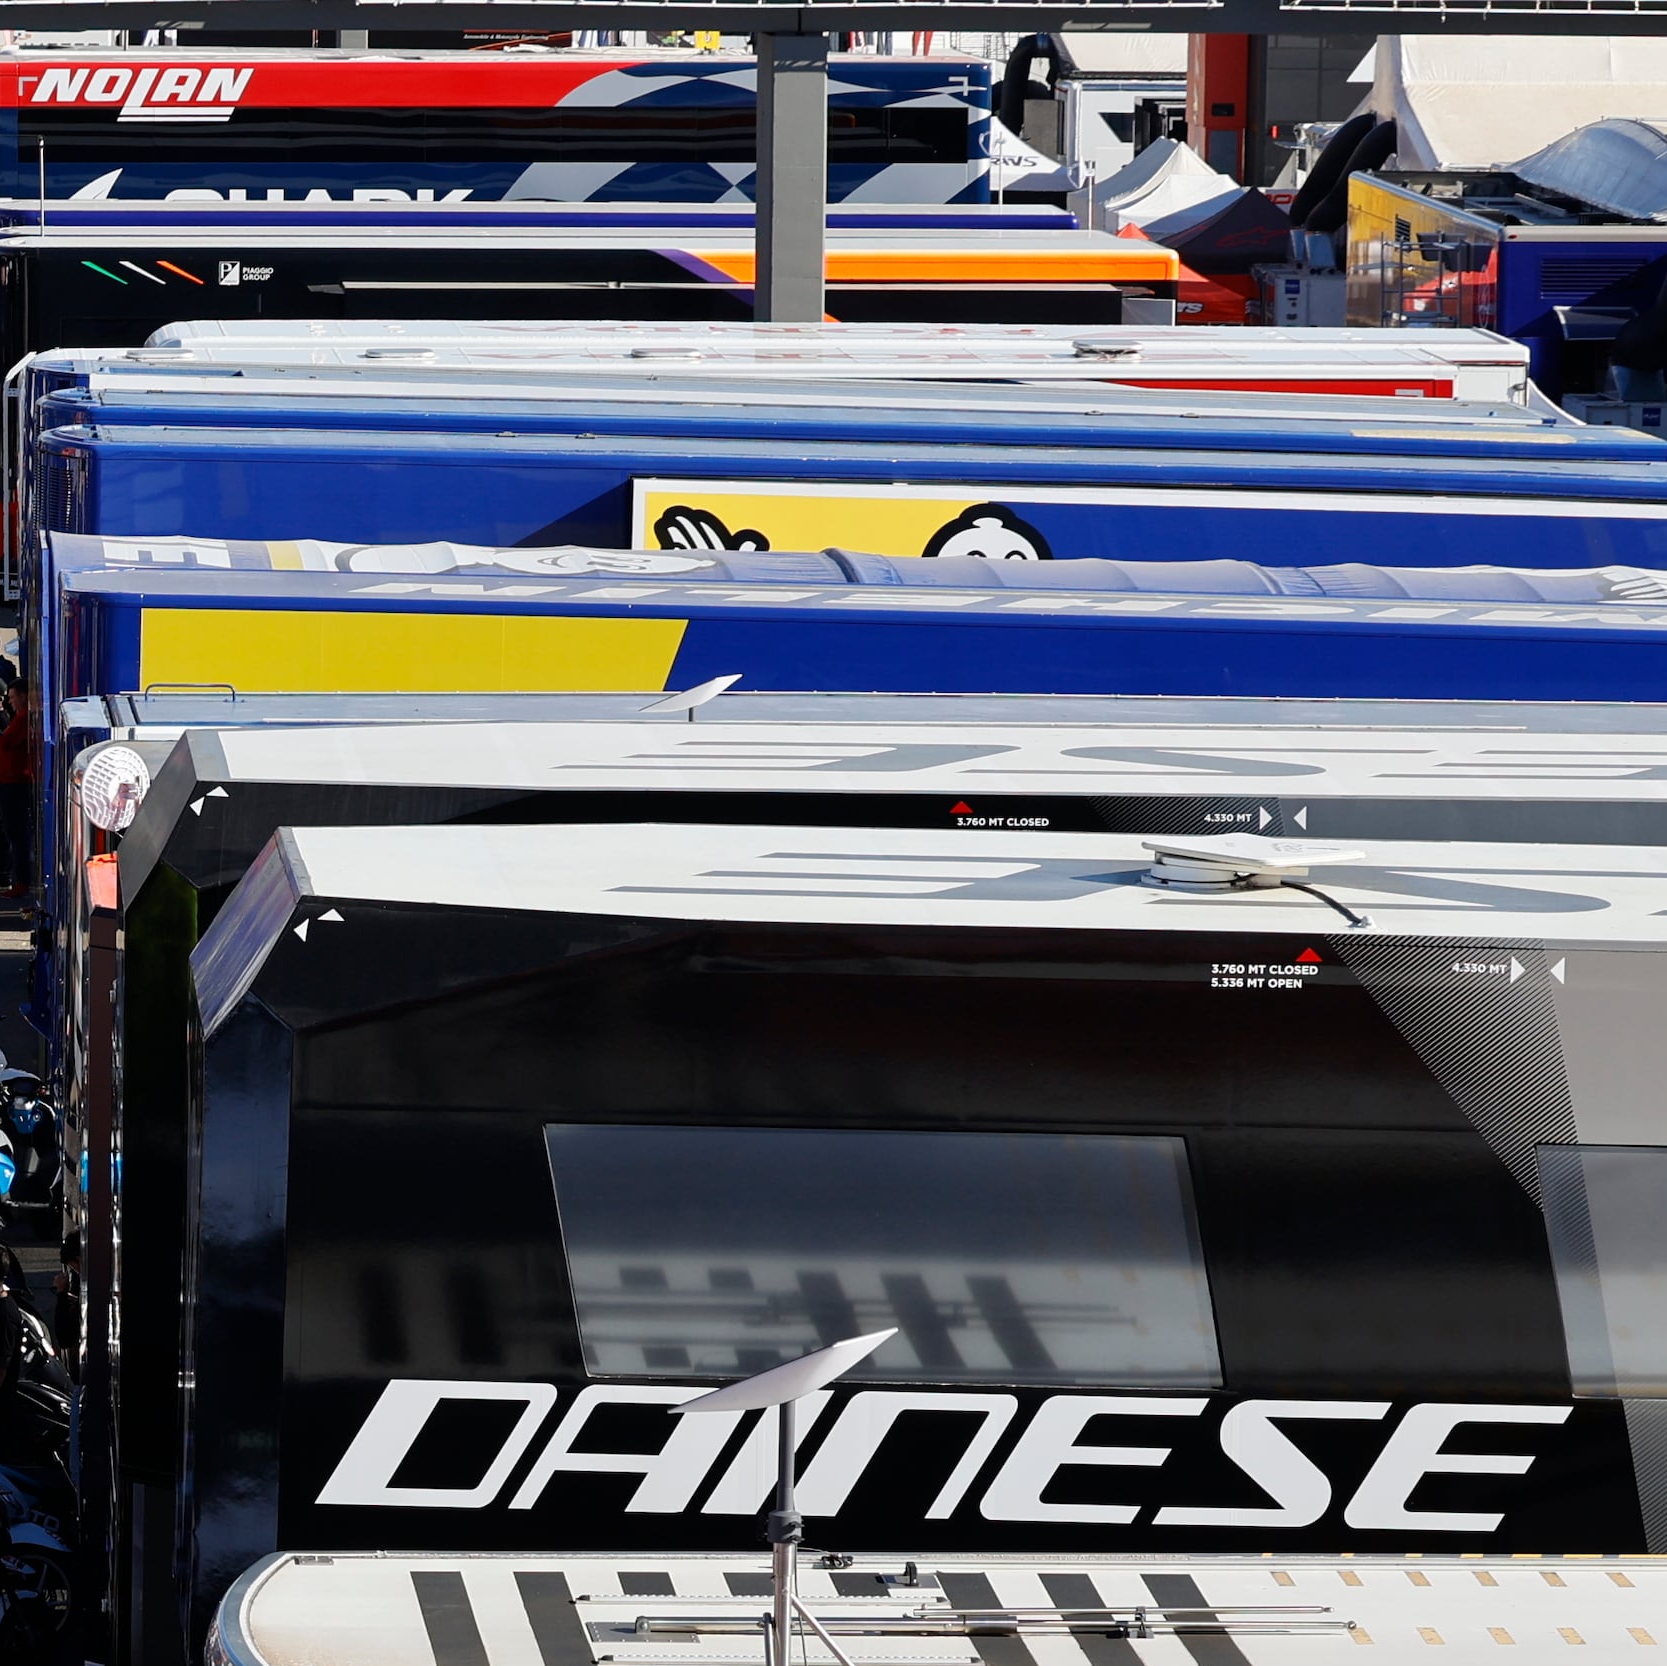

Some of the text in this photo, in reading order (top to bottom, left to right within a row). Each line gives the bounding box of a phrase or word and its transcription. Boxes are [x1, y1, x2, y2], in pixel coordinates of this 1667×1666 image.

[30, 68, 253, 122] NOLAN
[242, 266, 274, 275] PIAGGIO
[242, 274, 271, 282] GROUP
[957, 816, 1050, 829] 3.760 MT CLOSED
[1204, 812, 1253, 825] 4.330 MT
[1211, 963, 1319, 978] 3.760 MT CLOSED
[1452, 961, 1508, 976] 4.330 MT
[1211, 977, 1303, 989] 5.336 MT OPEN
[315, 1378, 1572, 1532] DAINESE
